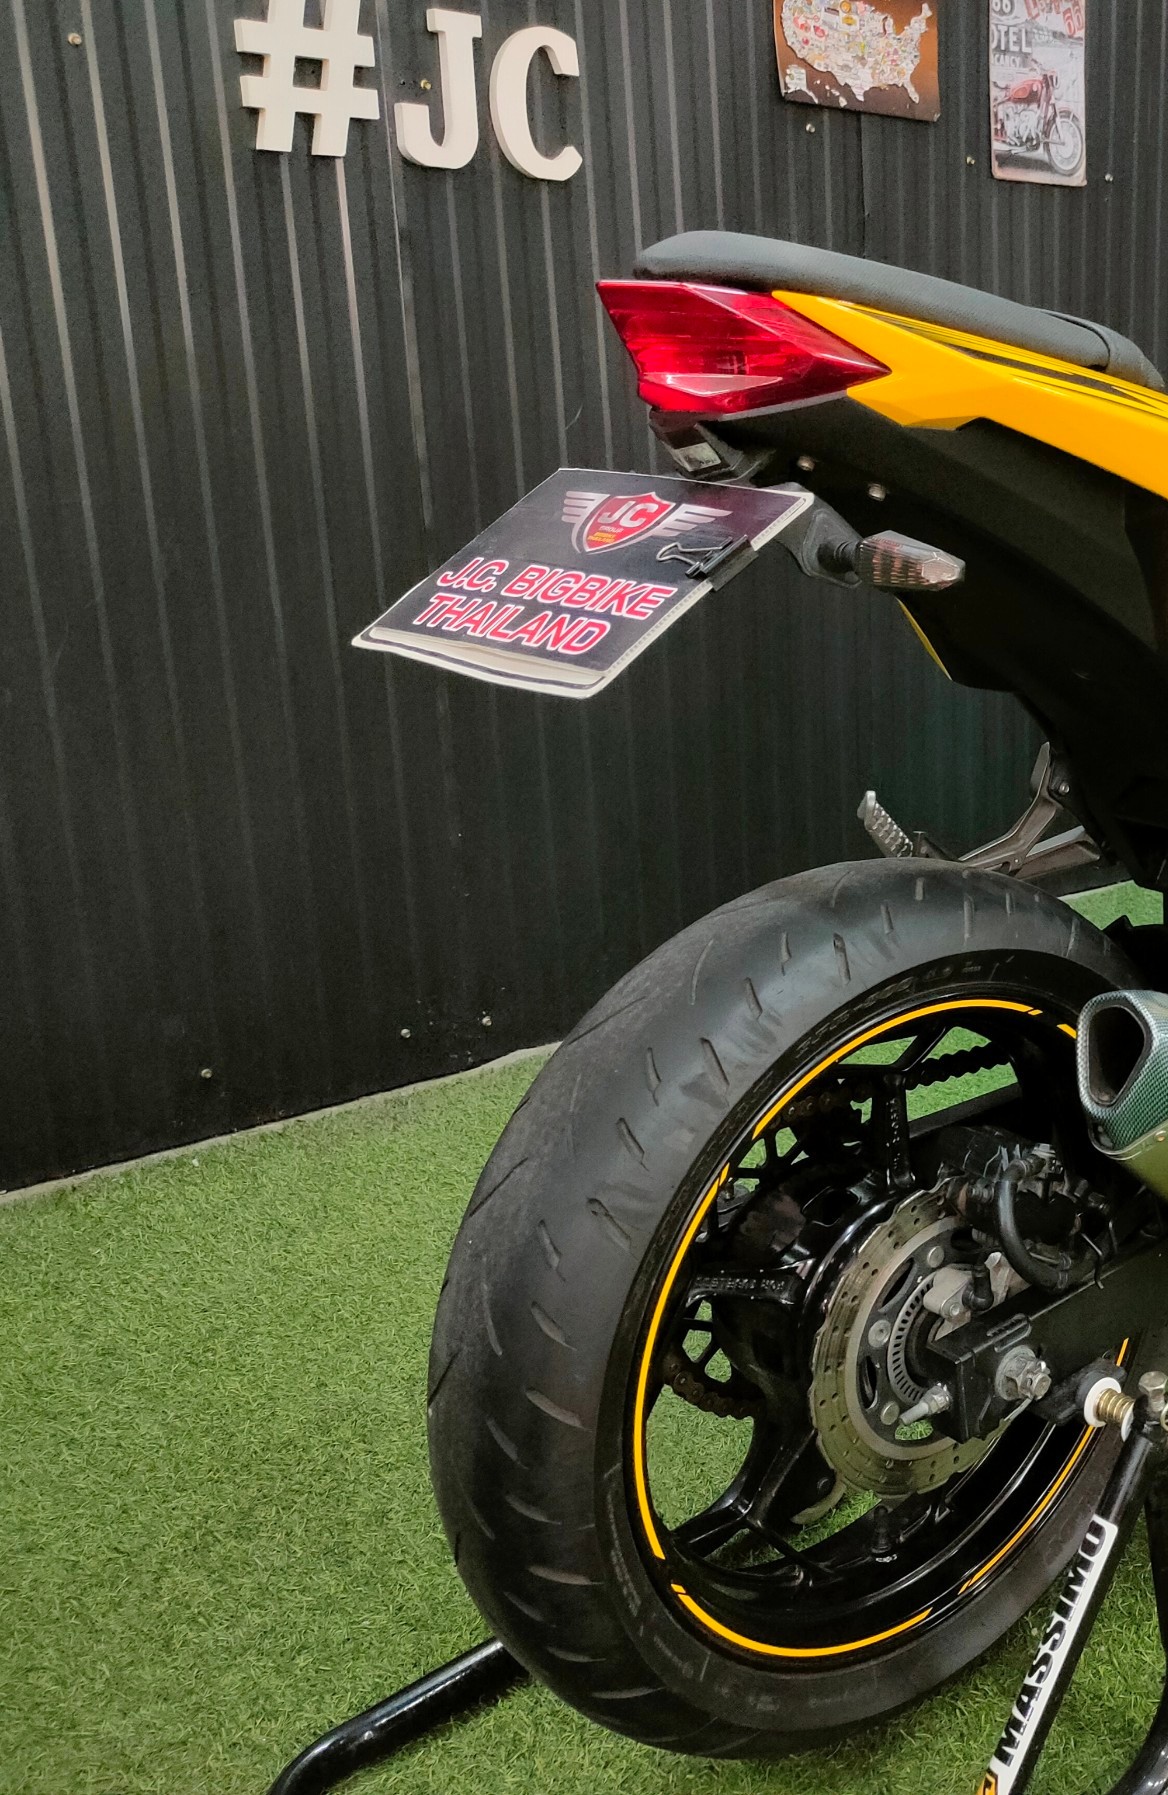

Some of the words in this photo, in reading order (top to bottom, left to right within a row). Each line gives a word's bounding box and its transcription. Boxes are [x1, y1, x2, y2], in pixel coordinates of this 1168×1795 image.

[234, 0, 583, 181] #JC
[597, 501, 659, 528] JC
[437, 557, 508, 591] J.C.
[502, 564, 677, 621] BIGBIKE
[413, 593, 611, 654] THAILAND
[993, 1518, 1108, 1767] MASSIMO
